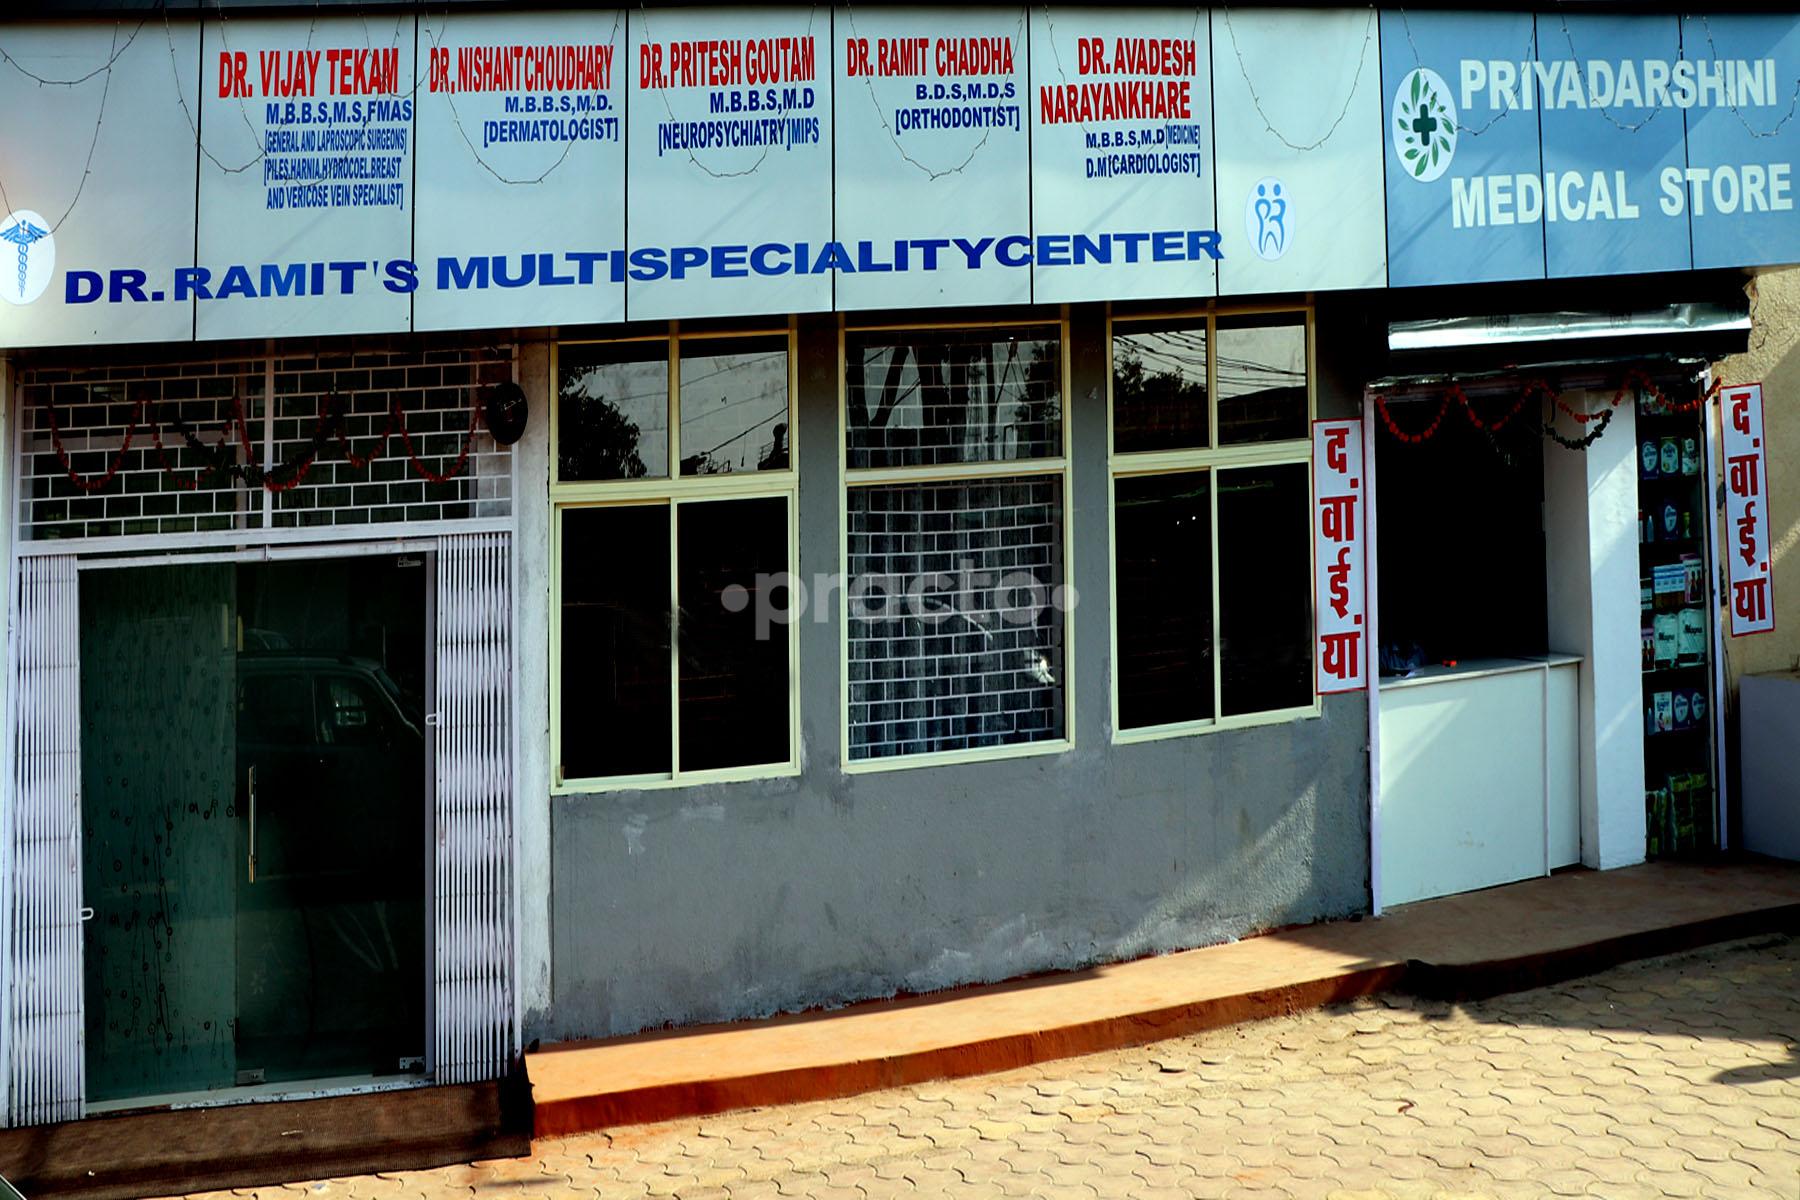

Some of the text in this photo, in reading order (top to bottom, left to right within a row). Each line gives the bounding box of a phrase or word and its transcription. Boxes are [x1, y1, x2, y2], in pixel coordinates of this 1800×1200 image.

[260, 50, 320, 97] VIJAY
[327, 48, 398, 95] TEKAM
[671, 40, 741, 88] PRITESH
[746, 36, 815, 85] GOUTAM
[878, 38, 928, 76] RAMIT
[936, 37, 1013, 77] CHADDHA
[1114, 38, 1196, 76] AVADESH
[916, 83, 1015, 101] B.D.S,M.D.S
[1040, 81, 1190, 124] NARAYANKHARE
[1461, 58, 1777, 111] PRIYADARSHINI
[484, 118, 618, 148] [DERMATOLOGIST]
[896, 106, 1020, 135] [ORTHODONTIST]
[301, 130, 315, 152] AND
[317, 130, 365, 151] LAPROSCOPIC
[267, 186, 284, 209] AND
[286, 185, 328, 207] VERICOSE
[331, 185, 351, 207] VEIN
[1451, 163, 1793, 229] MEDICAL STORE
